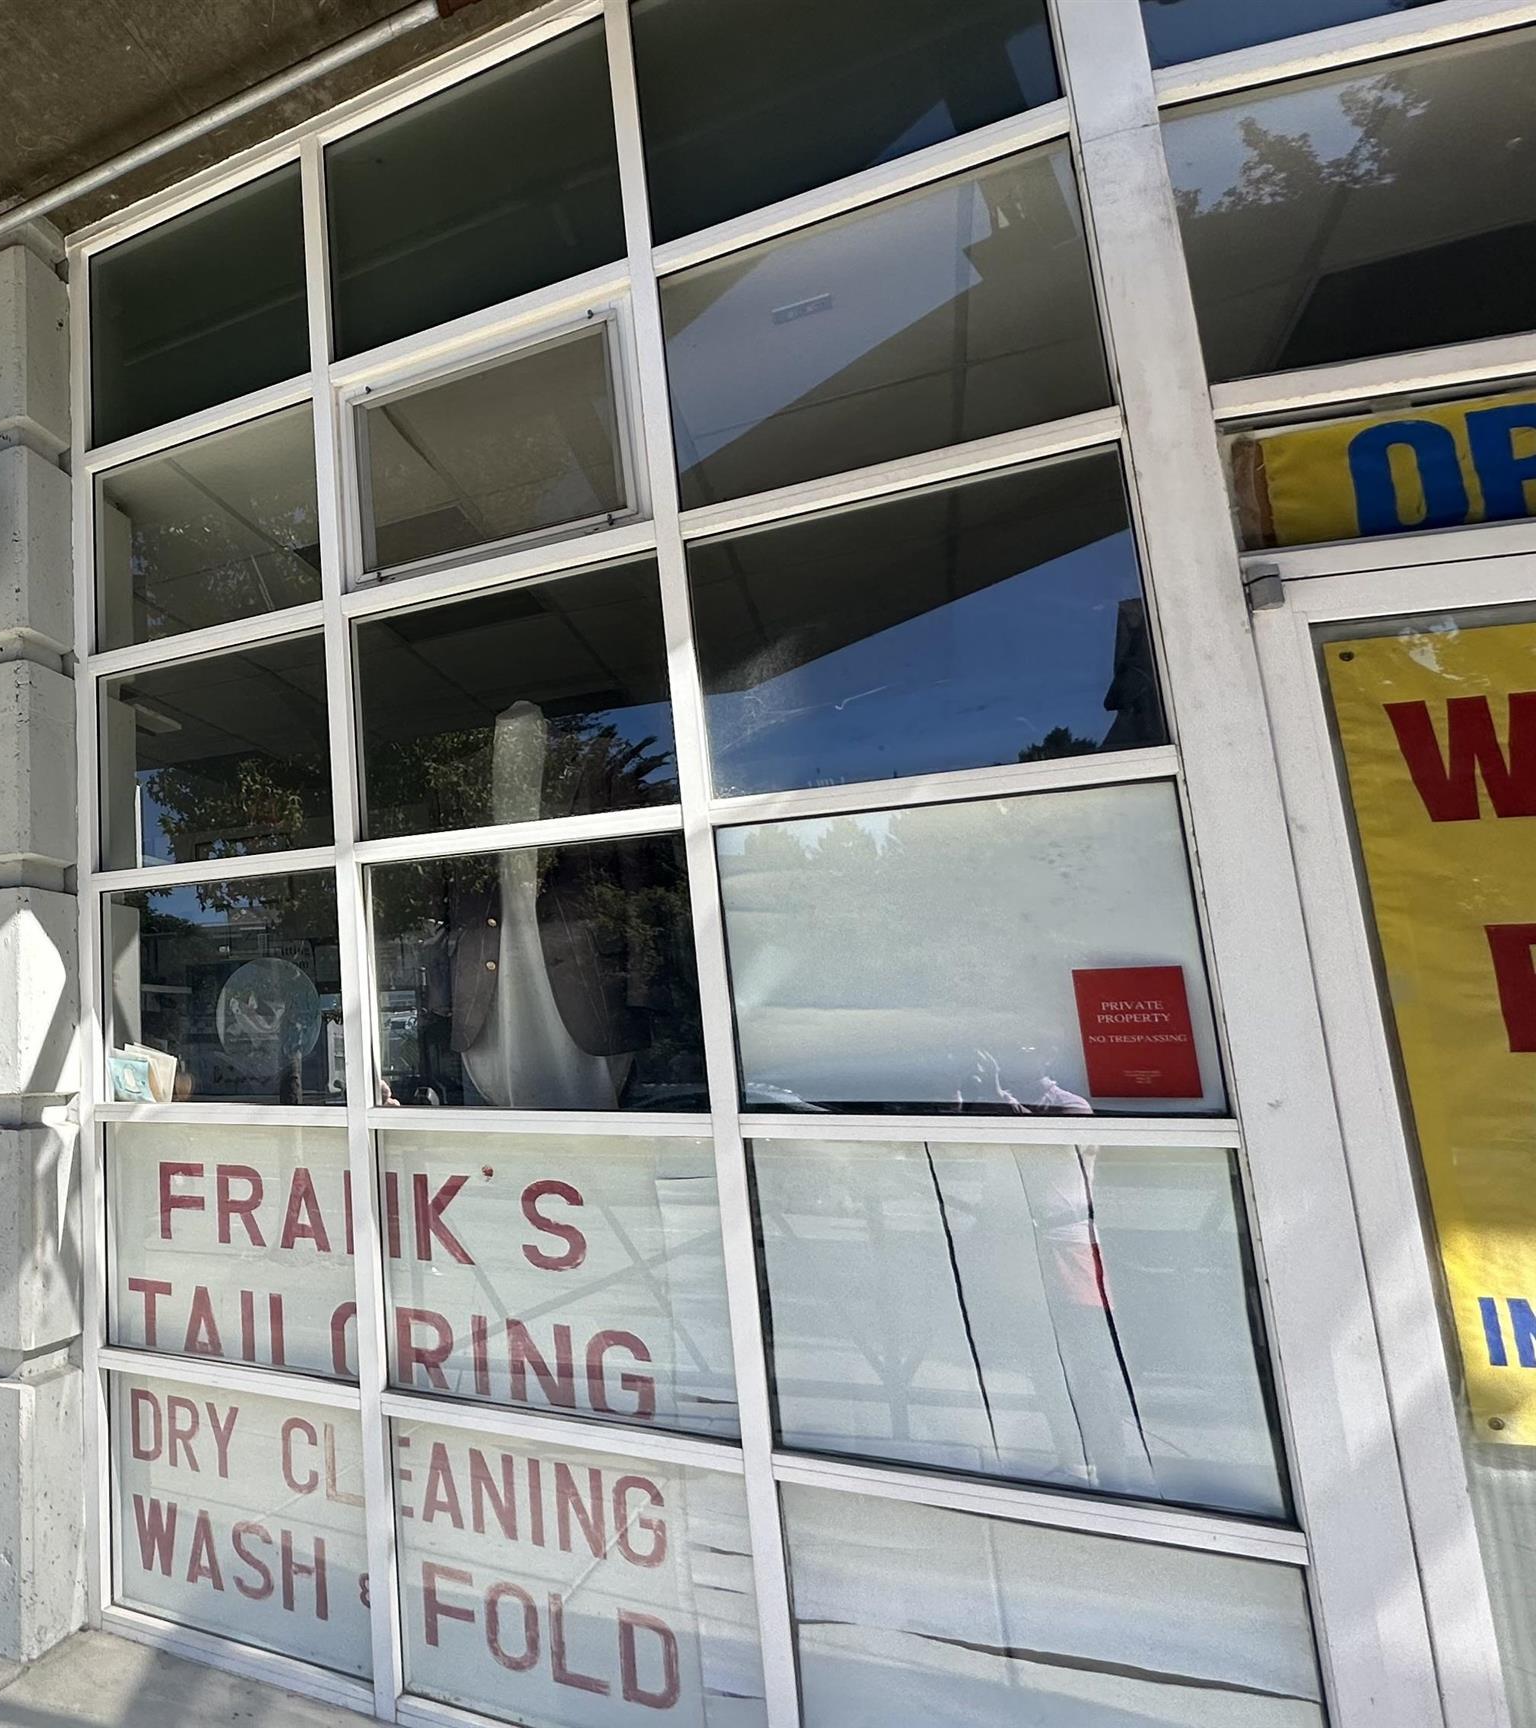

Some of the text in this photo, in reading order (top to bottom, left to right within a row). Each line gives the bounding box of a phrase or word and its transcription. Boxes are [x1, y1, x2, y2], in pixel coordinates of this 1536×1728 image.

[1101, 1000, 1164, 1011] PRIVATE
[1097, 1013, 1171, 1023] PROPERTY
[1088, 1034, 1188, 1043] NO TRESPASSING
[131, 1388, 239, 1478] DRY
[133, 1494, 681, 1710] WASH FOLD
